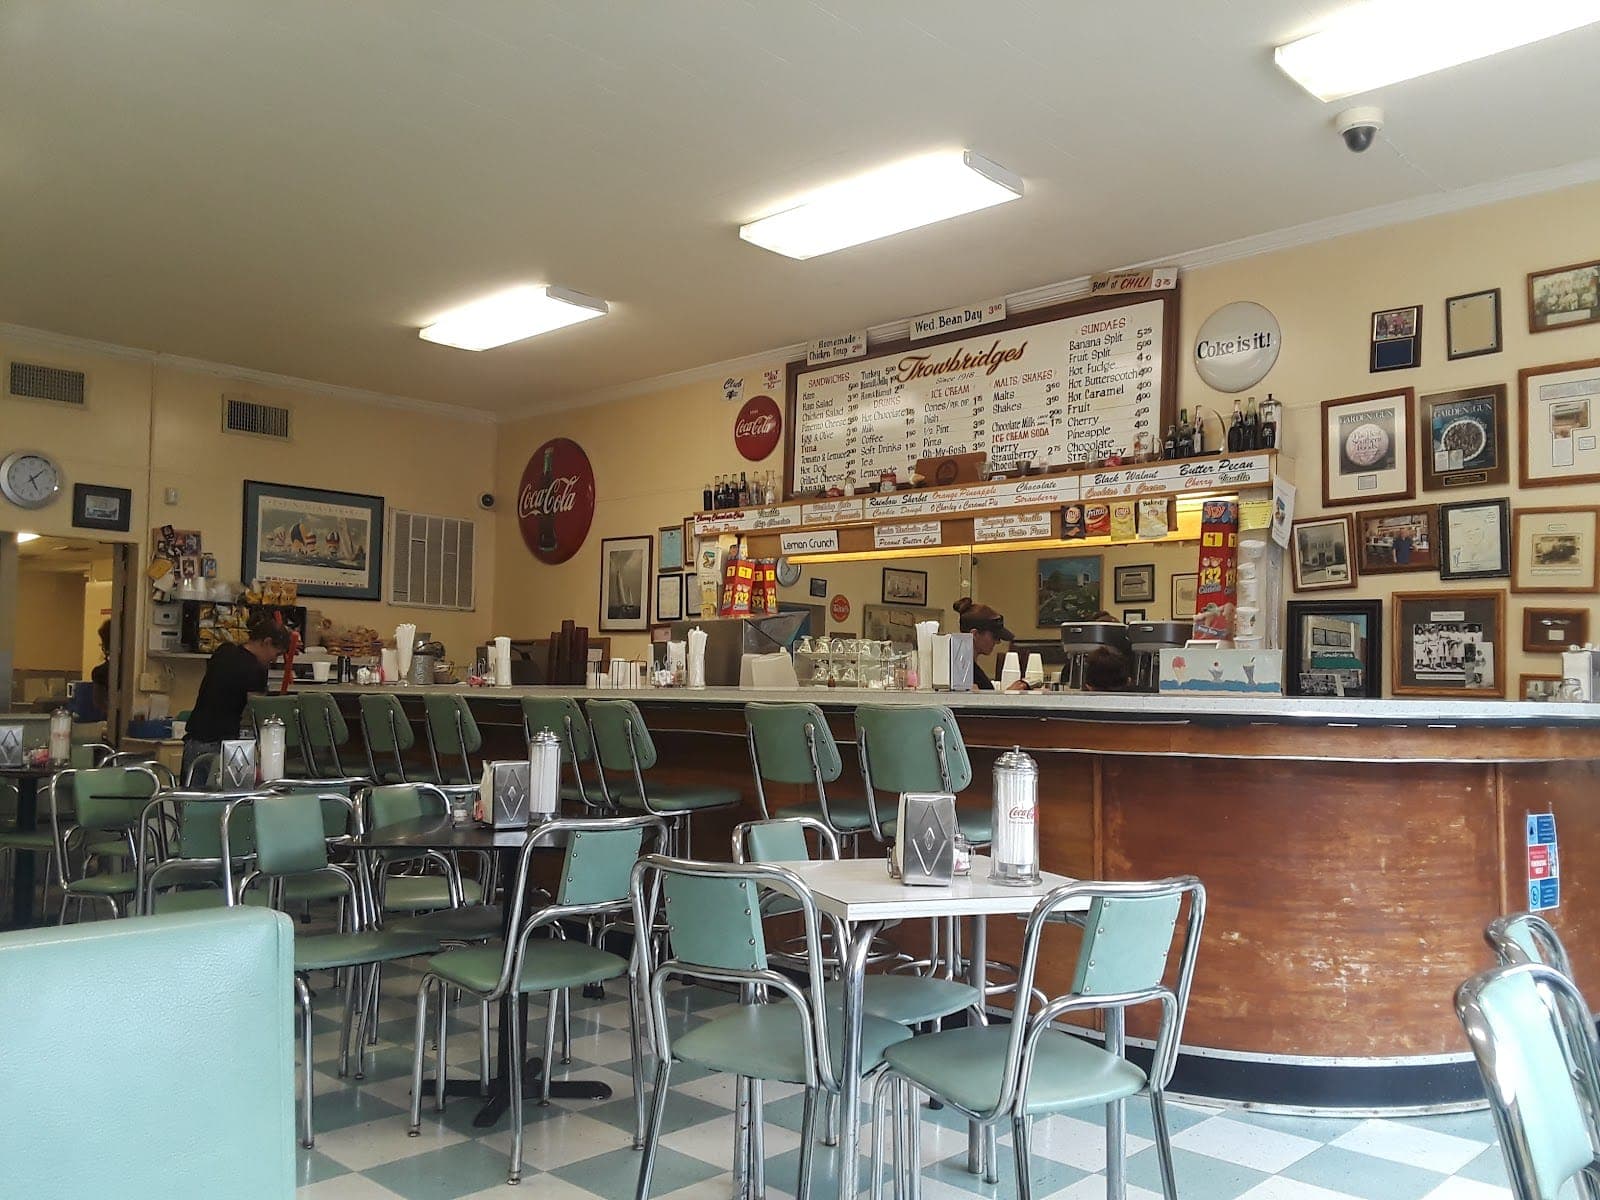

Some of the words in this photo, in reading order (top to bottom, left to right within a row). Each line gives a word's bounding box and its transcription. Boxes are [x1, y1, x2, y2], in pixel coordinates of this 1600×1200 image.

[1120, 276, 1150, 290] CHILI
[938, 314, 962, 328] Bean
[964, 309, 982, 322] Day
[1081, 318, 1126, 336] SUNDAES
[818, 334, 856, 348] Homemade
[1070, 338, 1101, 350] Banana
[1104, 332, 1123, 346] Split
[1198, 340, 1234, 359] Coke
[1237, 336, 1250, 352] is
[1254, 332, 1270, 350] it!
[896, 340, 1028, 382] Trowbridges
[1069, 350, 1088, 364] Fruit
[1092, 348, 1111, 361] Split
[860, 370, 880, 380] Turkey
[1069, 366, 1083, 376] Hot
[1087, 361, 1115, 374] Fudge
[808, 372, 850, 388] SANDWICHES
[958, 372, 976, 382] 1918
[1068, 379, 1082, 390] Hot
[1084, 369, 1138, 386] Butterscotch
[724, 378, 744, 390] Club
[802, 392, 815, 400] Ham
[931, 389, 942, 399] ICE
[944, 384, 970, 397] CREAM
[993, 391, 1014, 402] Malts
[1068, 392, 1080, 402] Hot
[1084, 384, 1124, 400] Caramel
[802, 402, 814, 411] Ham
[816, 398, 834, 408] Salad
[874, 396, 900, 408] DRINKS
[992, 402, 1022, 414] Shakes
[802, 410, 824, 422] Chicken
[826, 407, 844, 418] Salad
[874, 410, 905, 420] Chocolate
[1068, 403, 1091, 415] Fruit
[1434, 407, 1468, 418] GARDEN
[1473, 404, 1492, 412] GUN
[824, 419, 846, 429] Cheese
[924, 415, 939, 424] Dish
[992, 420, 1020, 432] Chocolate
[1022, 416, 1036, 428] Milk
[1068, 416, 1100, 428] Cherry
[936, 425, 950, 434] Pint
[992, 434, 1004, 444] ICE
[1006, 430, 1029, 442] CREAM
[1031, 428, 1050, 438] SODA
[1068, 426, 1111, 440] Pineapple
[862, 435, 883, 444] Coffee
[923, 438, 942, 447] Pints
[1066, 440, 1114, 452] Chocolate
[800, 444, 816, 454] Tuna
[861, 446, 874, 456] Soft
[878, 443, 902, 454] Drinks
[922, 444, 966, 458] Oh-My-Gosh
[992, 442, 1020, 454] Cherry
[802, 455, 820, 464] Tomato
[862, 458, 873, 466] Tea
[992, 450, 1038, 462] Strawberry
[800, 466, 810, 474] Hot
[814, 464, 826, 472] Dog
[860, 466, 896, 478] Lemonade
[1094, 474, 1119, 484] Black
[1124, 470, 1158, 481] Walnut
[1179, 464, 1215, 476] Butter
[1218, 460, 1254, 472] Pecan
[820, 473, 844, 483] Cheese
[869, 496, 898, 507] Rainbow
[902, 494, 928, 504] Sherbet
[932, 490, 958, 500] Orange
[960, 486, 998, 498] Pineapple
[1016, 481, 1056, 493] Chocolate
[1084, 487, 1118, 498] Cookies
[1136, 483, 1166, 494] Cream
[1184, 477, 1213, 488] Cherry
[520, 476, 580, 518] Coca-Cola
[872, 506, 895, 516] Cookie
[900, 505, 922, 516] Dough
[962, 500, 988, 510] Caramel
[988, 499, 998, 508] Pie
[1014, 494, 1058, 504] Strawberry
[784, 539, 808, 551] Lemon
[809, 538, 835, 550] Crunch
[878, 537, 900, 546] Peanut
[902, 536, 922, 545] Butter
[924, 534, 936, 545] Cup
